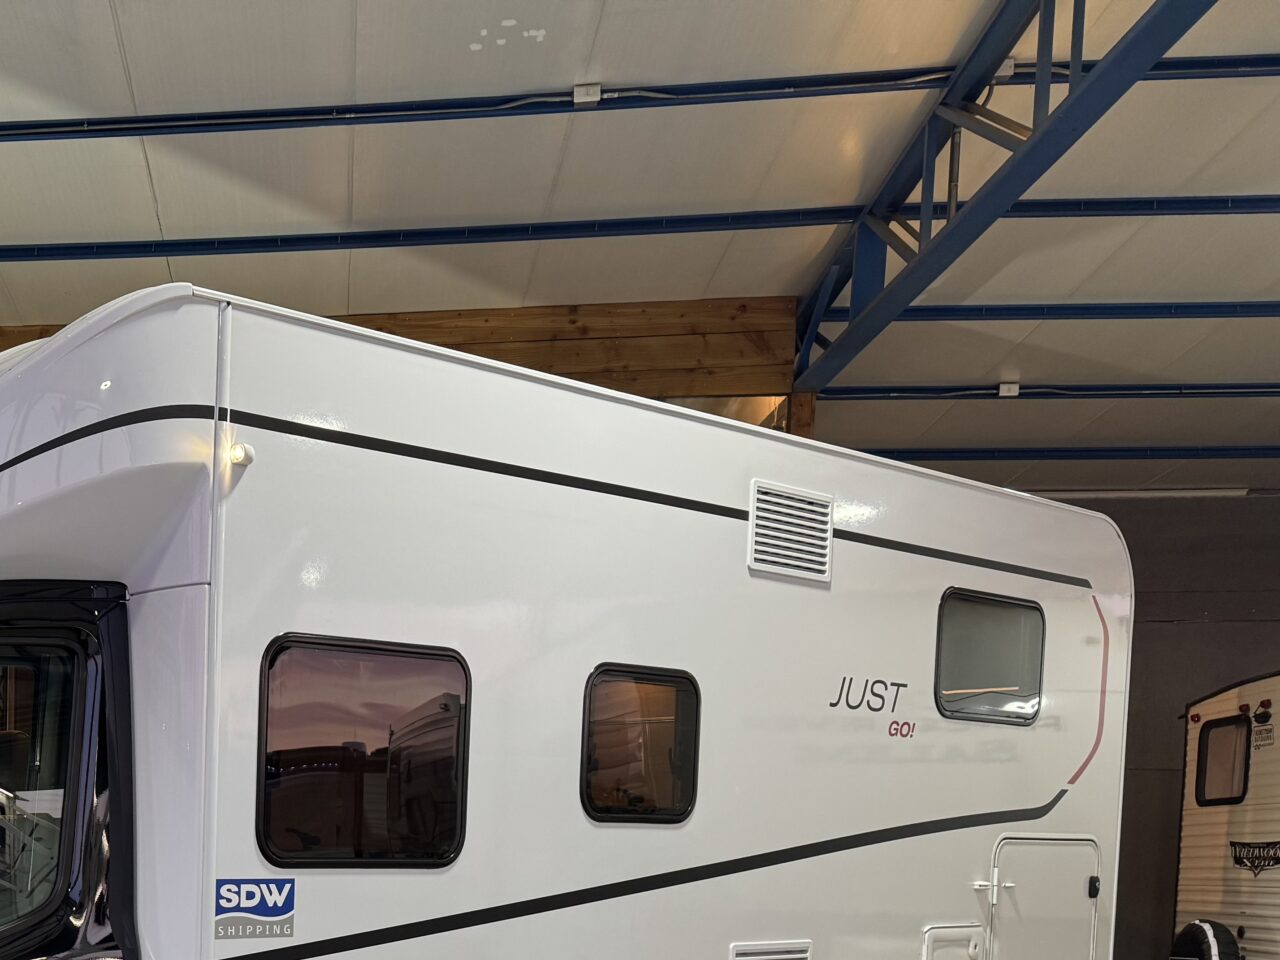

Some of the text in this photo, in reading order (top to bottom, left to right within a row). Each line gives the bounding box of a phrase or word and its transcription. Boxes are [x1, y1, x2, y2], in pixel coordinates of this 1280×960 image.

[829, 676, 908, 713] JUST
[888, 720, 916, 738] GO!
[218, 884, 292, 908] SDW
[218, 924, 291, 936] SHIPPING
